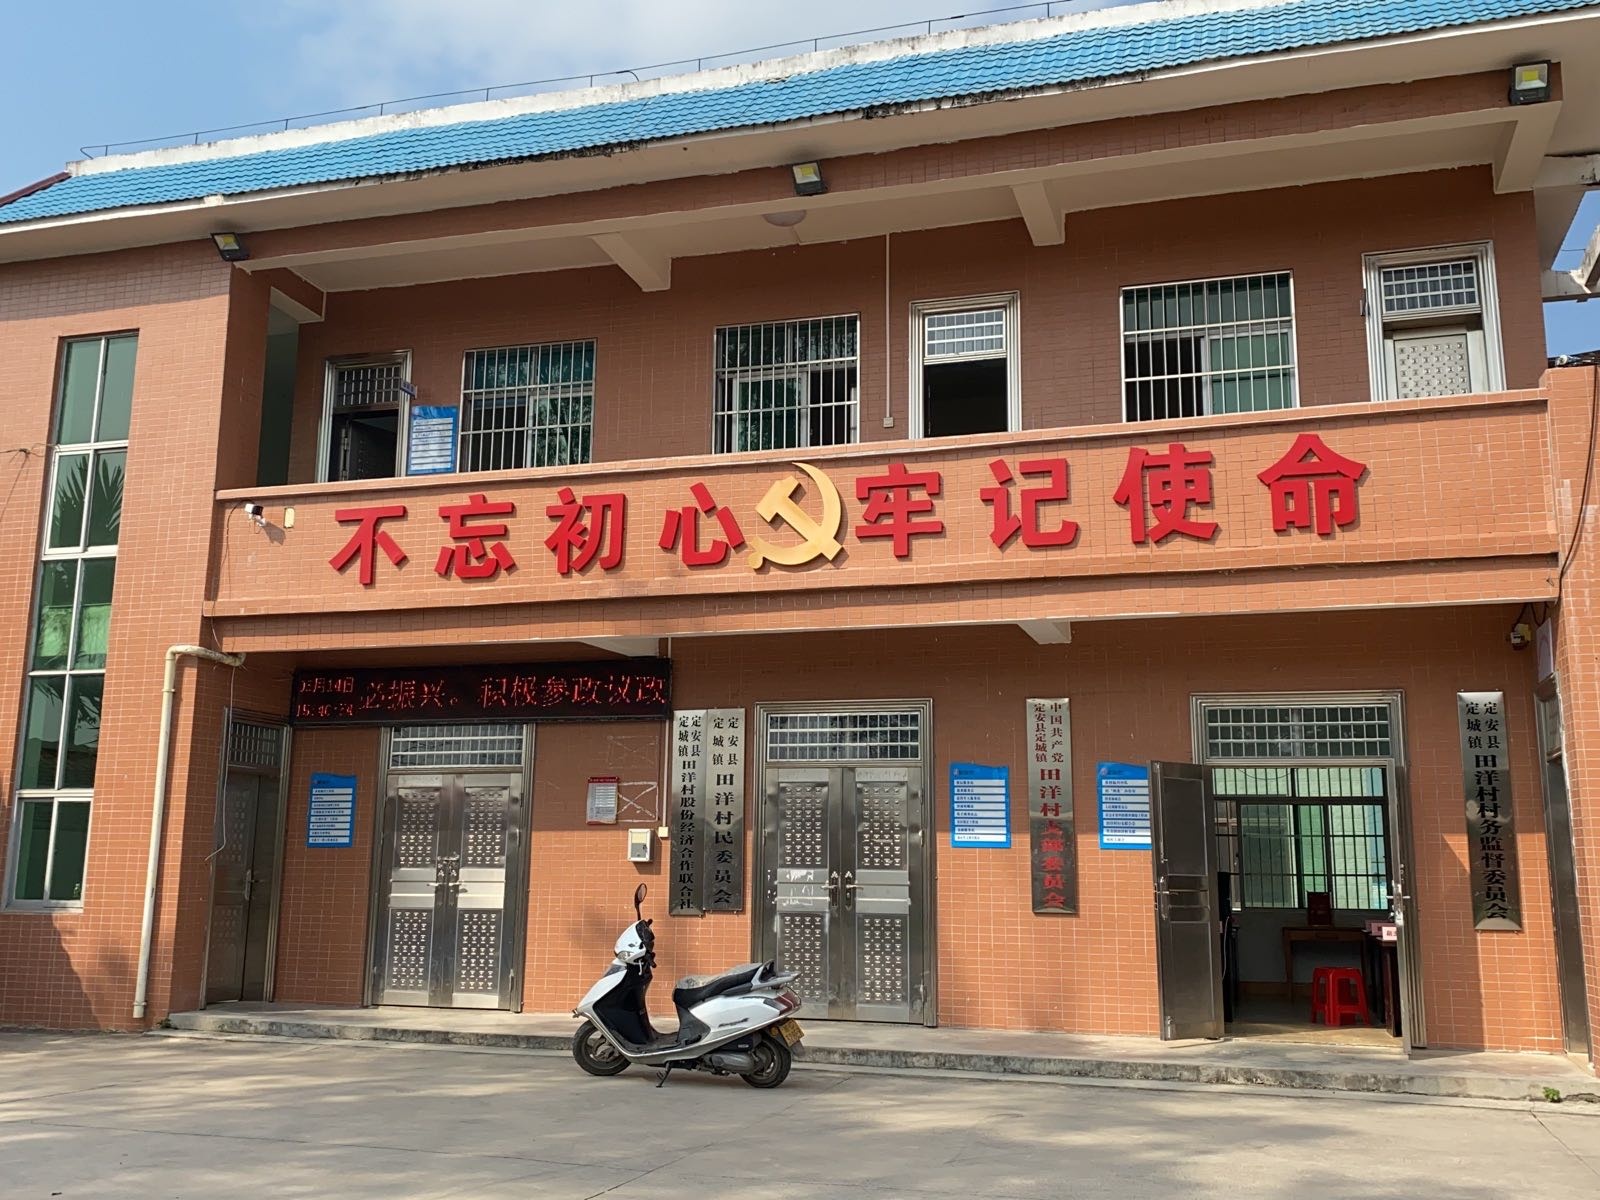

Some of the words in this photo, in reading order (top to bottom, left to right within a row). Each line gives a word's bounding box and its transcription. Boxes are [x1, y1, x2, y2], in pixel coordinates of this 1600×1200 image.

[329, 482, 745, 585] 不忘初心
[855, 433, 1367, 558] 牢记使命
[678, 715, 689, 757] 定城镇
[691, 715, 702, 757] 定安县
[712, 716, 724, 766] 定城镇
[727, 716, 739, 766] 定安县
[1034, 702, 1048, 763] 定安县定城镇
[1050, 702, 1064, 763] 中国共产党
[1465, 702, 1482, 750] 定城镇
[1483, 701, 1500, 750] 定安县
[679, 760, 697, 910] 田洋村股份经济合作联合社
[713, 773, 735, 905] 田洋村民委员会
[1474, 754, 1508, 920] 田洋村村务监督委员会
